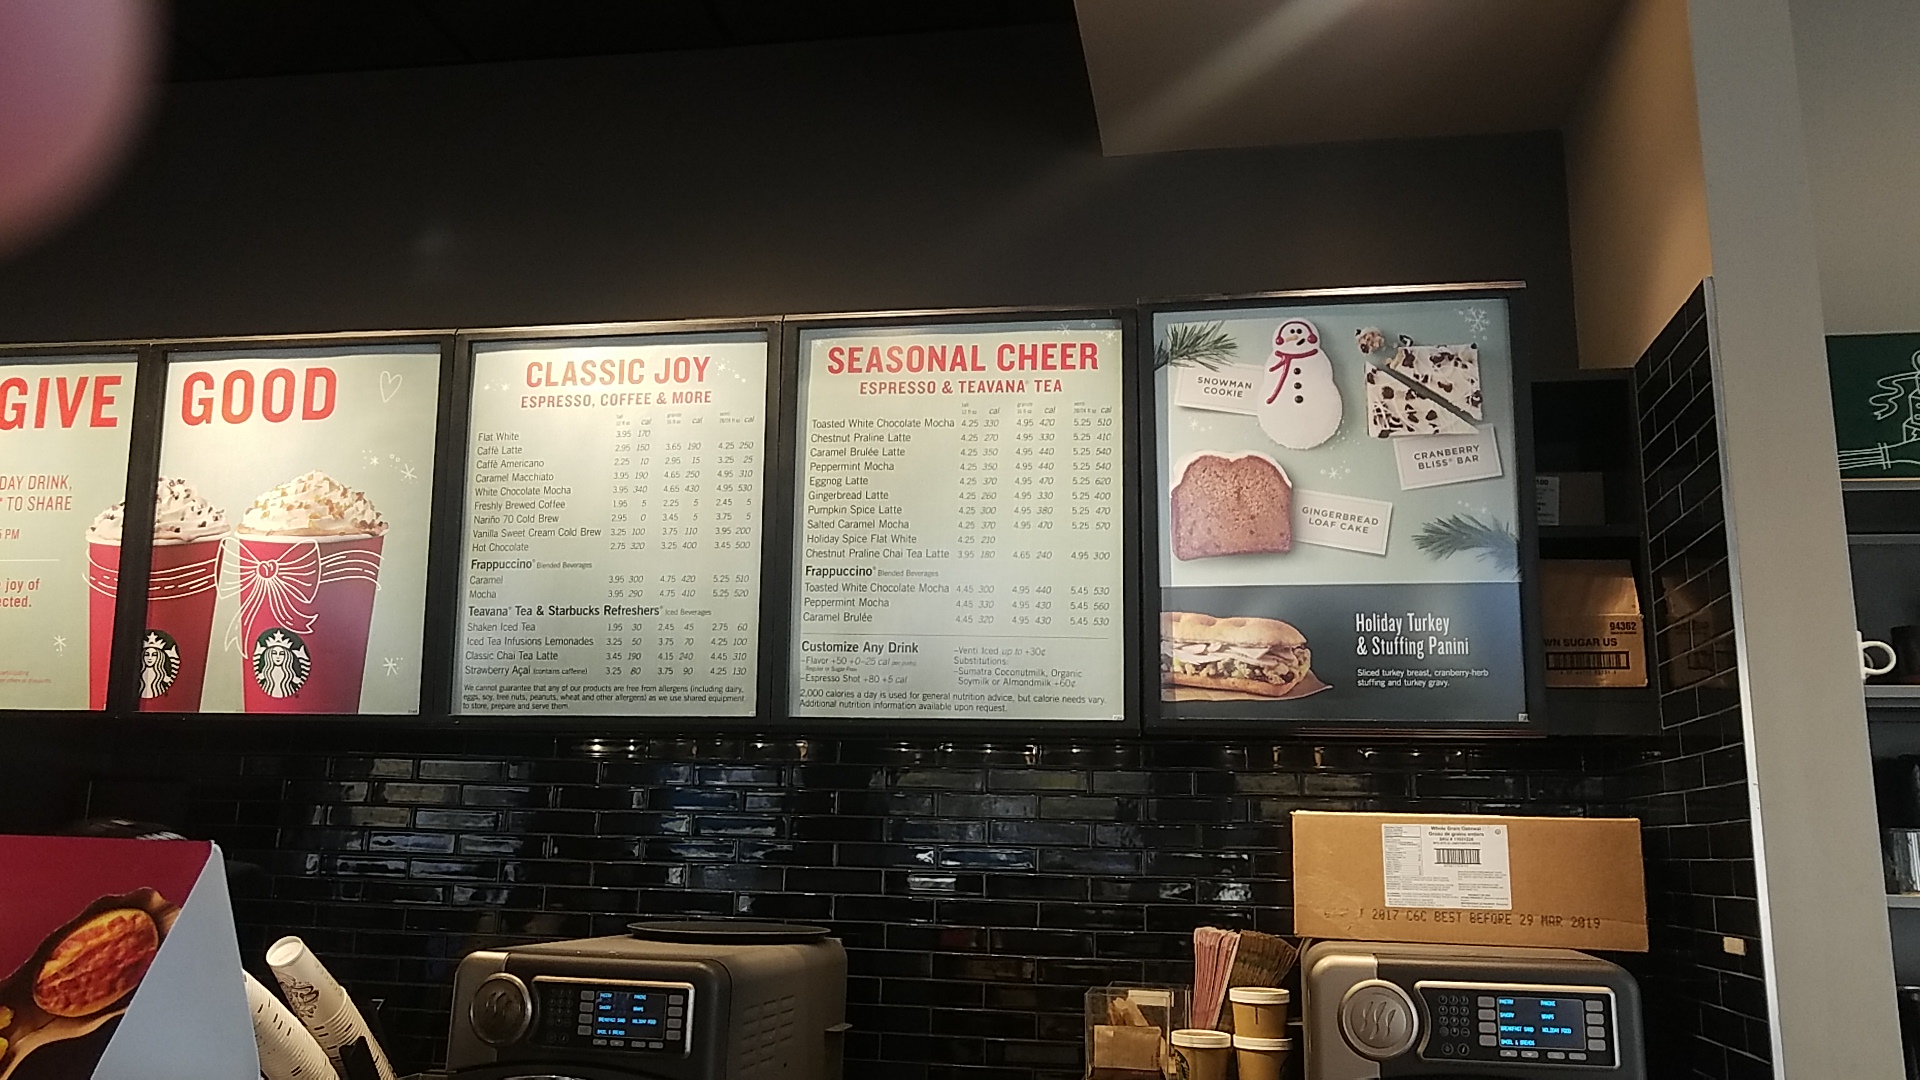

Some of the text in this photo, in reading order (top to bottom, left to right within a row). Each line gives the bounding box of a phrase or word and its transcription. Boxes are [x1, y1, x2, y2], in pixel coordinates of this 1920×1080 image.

[827, 342, 1099, 375] SEASONAL CHEER
[526, 356, 711, 387] CLASSIC JOY
[860, 381, 936, 395] ESPRESSO
[942, 381, 953, 394] &
[1034, 379, 1062, 392] TEA
[1197, 377, 1252, 389] SNOWMAN
[181, 367, 338, 426] GOOD
[1203, 387, 1243, 398] COOKIE
[0, 375, 122, 430] GIVE
[521, 391, 712, 408] ESPRESSO, COFFEE & MORE
[812, 419, 954, 428] Toasted White Chocolate Mocha
[961, 418, 1112, 427] 4.25 330 4.95 420 5.25 510
[478, 432, 519, 441] Flat White
[811, 433, 911, 443] Chestnut Praline Latte
[502, 445, 522, 454] Latte
[810, 447, 905, 457] Caramel Brulée Latte
[1414, 445, 1479, 460] CRANBERRY
[501, 459, 544, 468] Americano
[1457, 455, 1479, 464] BAR
[810, 462, 894, 472] Peppermint Mocha
[476, 472, 553, 482] Caramel Macchiato
[809, 476, 868, 487] Eggnog Latte
[28, 475, 72, 491] DRINK,
[475, 485, 571, 496] White Chocolate Mocha
[808, 491, 888, 501] Gingerbread Latte
[7, 496, 72, 511] TO SHARE
[474, 499, 565, 511] Freshly Brewed Coffee
[503, 515, 513, 523] 70
[516, 514, 536, 523] Cold
[538, 514, 559, 523] Brew
[1302, 506, 1379, 526] GINGERBREAD
[1308, 518, 1369, 534] LOAF CAKE
[5, 529, 20, 539] PM
[473, 527, 601, 538] Vanilla Sweet Cream Cold Brew
[807, 534, 916, 545] Holiday Spice Flat White
[470, 576, 503, 585] Caramel
[609, 575, 749, 583] 3.95 300 4.75 420 5.25 510
[5, 578, 40, 593] joy of
[515, 606, 532, 616] Tea
[536, 606, 544, 615] &
[548, 605, 600, 615] Starbucks
[467, 623, 535, 632] Shaken Iced Tea
[608, 623, 747, 631] 1.95 30 2.45 45 2.75 60
[1356, 613, 1450, 635] Holiday Turkey
[467, 637, 594, 646] Iced Tea Infusions Lemonades
[1563, 638, 1600, 646] SUGAR
[1603, 638, 1617, 646] US
[801, 641, 918, 654] Customize Any Drink
[1357, 636, 1469, 659] & Stuffing Panini
[465, 666, 509, 677] Strawberry
[1357, 669, 1488, 678] Sliced turkey breast, cranberry-herb
[958, 677, 989, 686] Soymilk
[1003, 678, 1051, 686] Almondmilk
[1357, 679, 1386, 688] stuffing
[1404, 679, 1426, 688] turkey
[1428, 680, 1450, 688] gravy.
[800, 700, 836, 708] Additional
[873, 701, 916, 709] information
[919, 702, 951, 710] available
[954, 704, 974, 713] upon
[976, 704, 1007, 713] request.
[1372, 912, 1399, 920] 2017
[1434, 913, 1462, 923] BEST
[1469, 914, 1512, 924] BEFORE
[1520, 915, 1533, 926] 29
[1541, 916, 1563, 926] MAR
[1571, 917, 1601, 929] 2019
